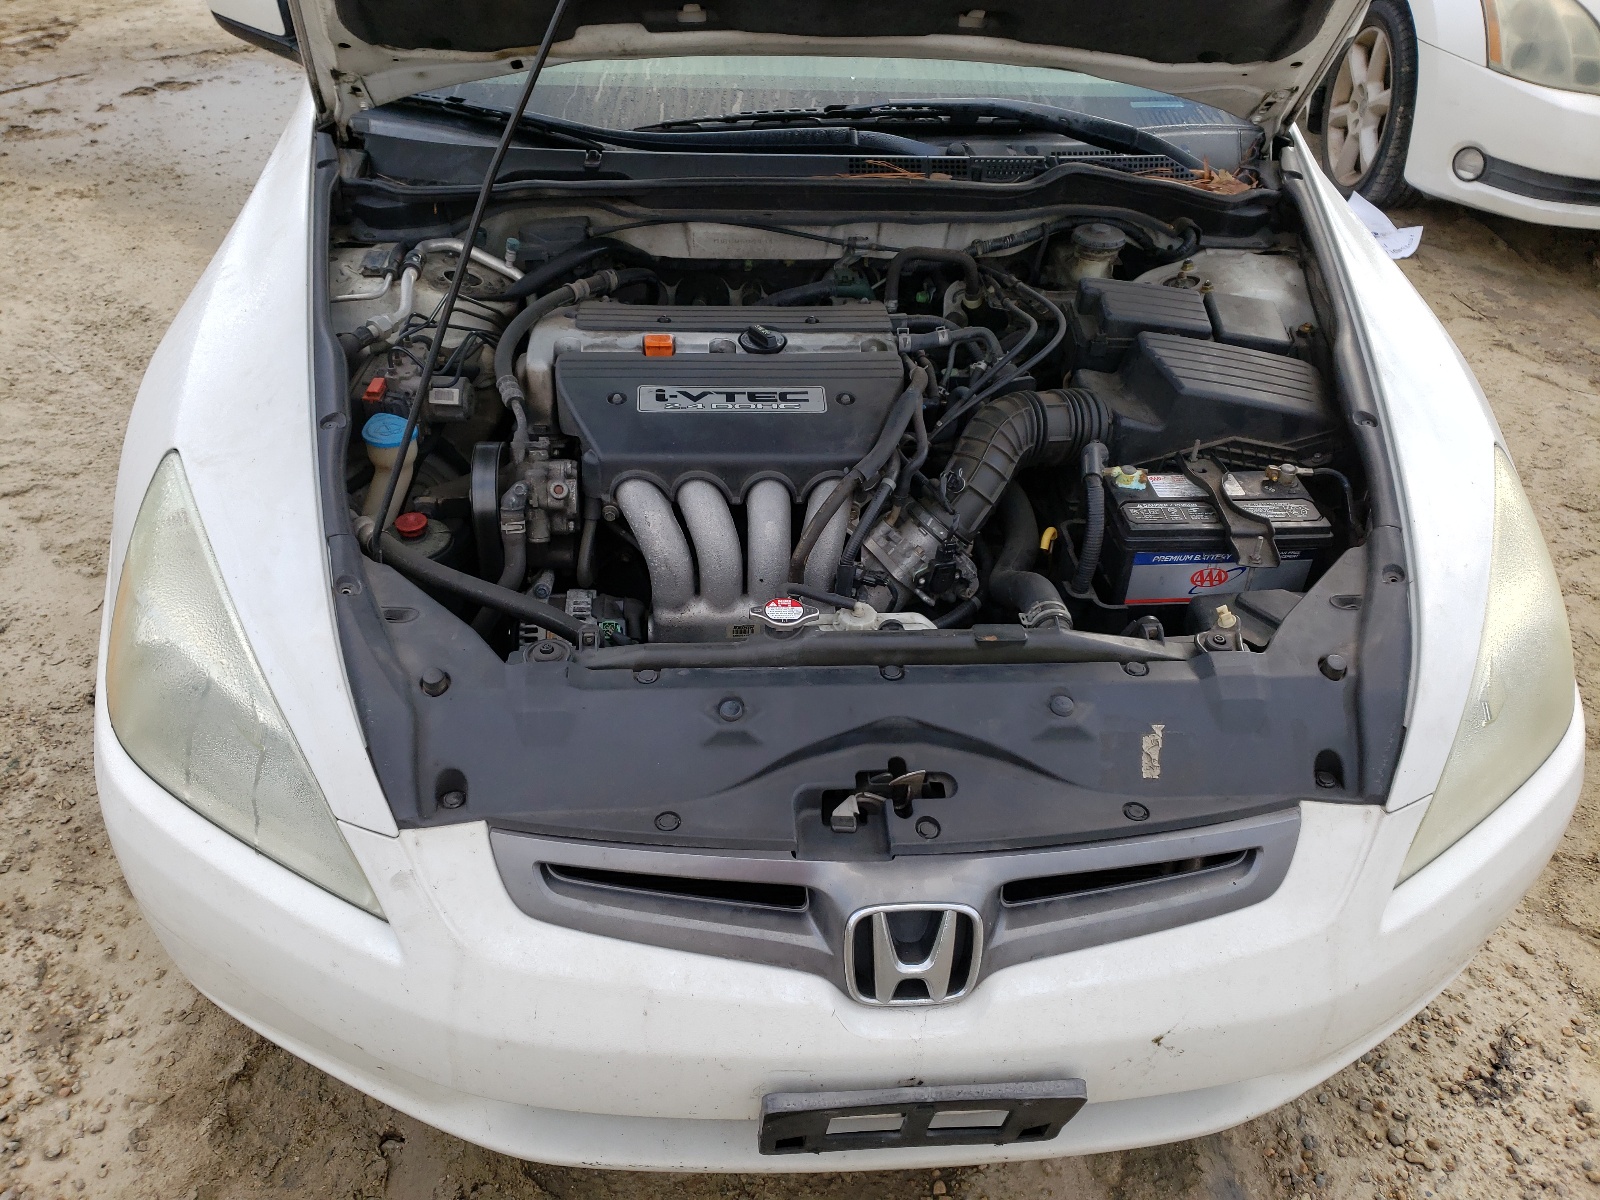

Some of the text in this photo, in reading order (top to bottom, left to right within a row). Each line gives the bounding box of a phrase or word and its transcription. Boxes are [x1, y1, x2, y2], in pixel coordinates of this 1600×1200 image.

[655, 388, 809, 402] i-VTEC
[1194, 553, 1232, 561] BATTERY
[1192, 568, 1227, 587] AAA
